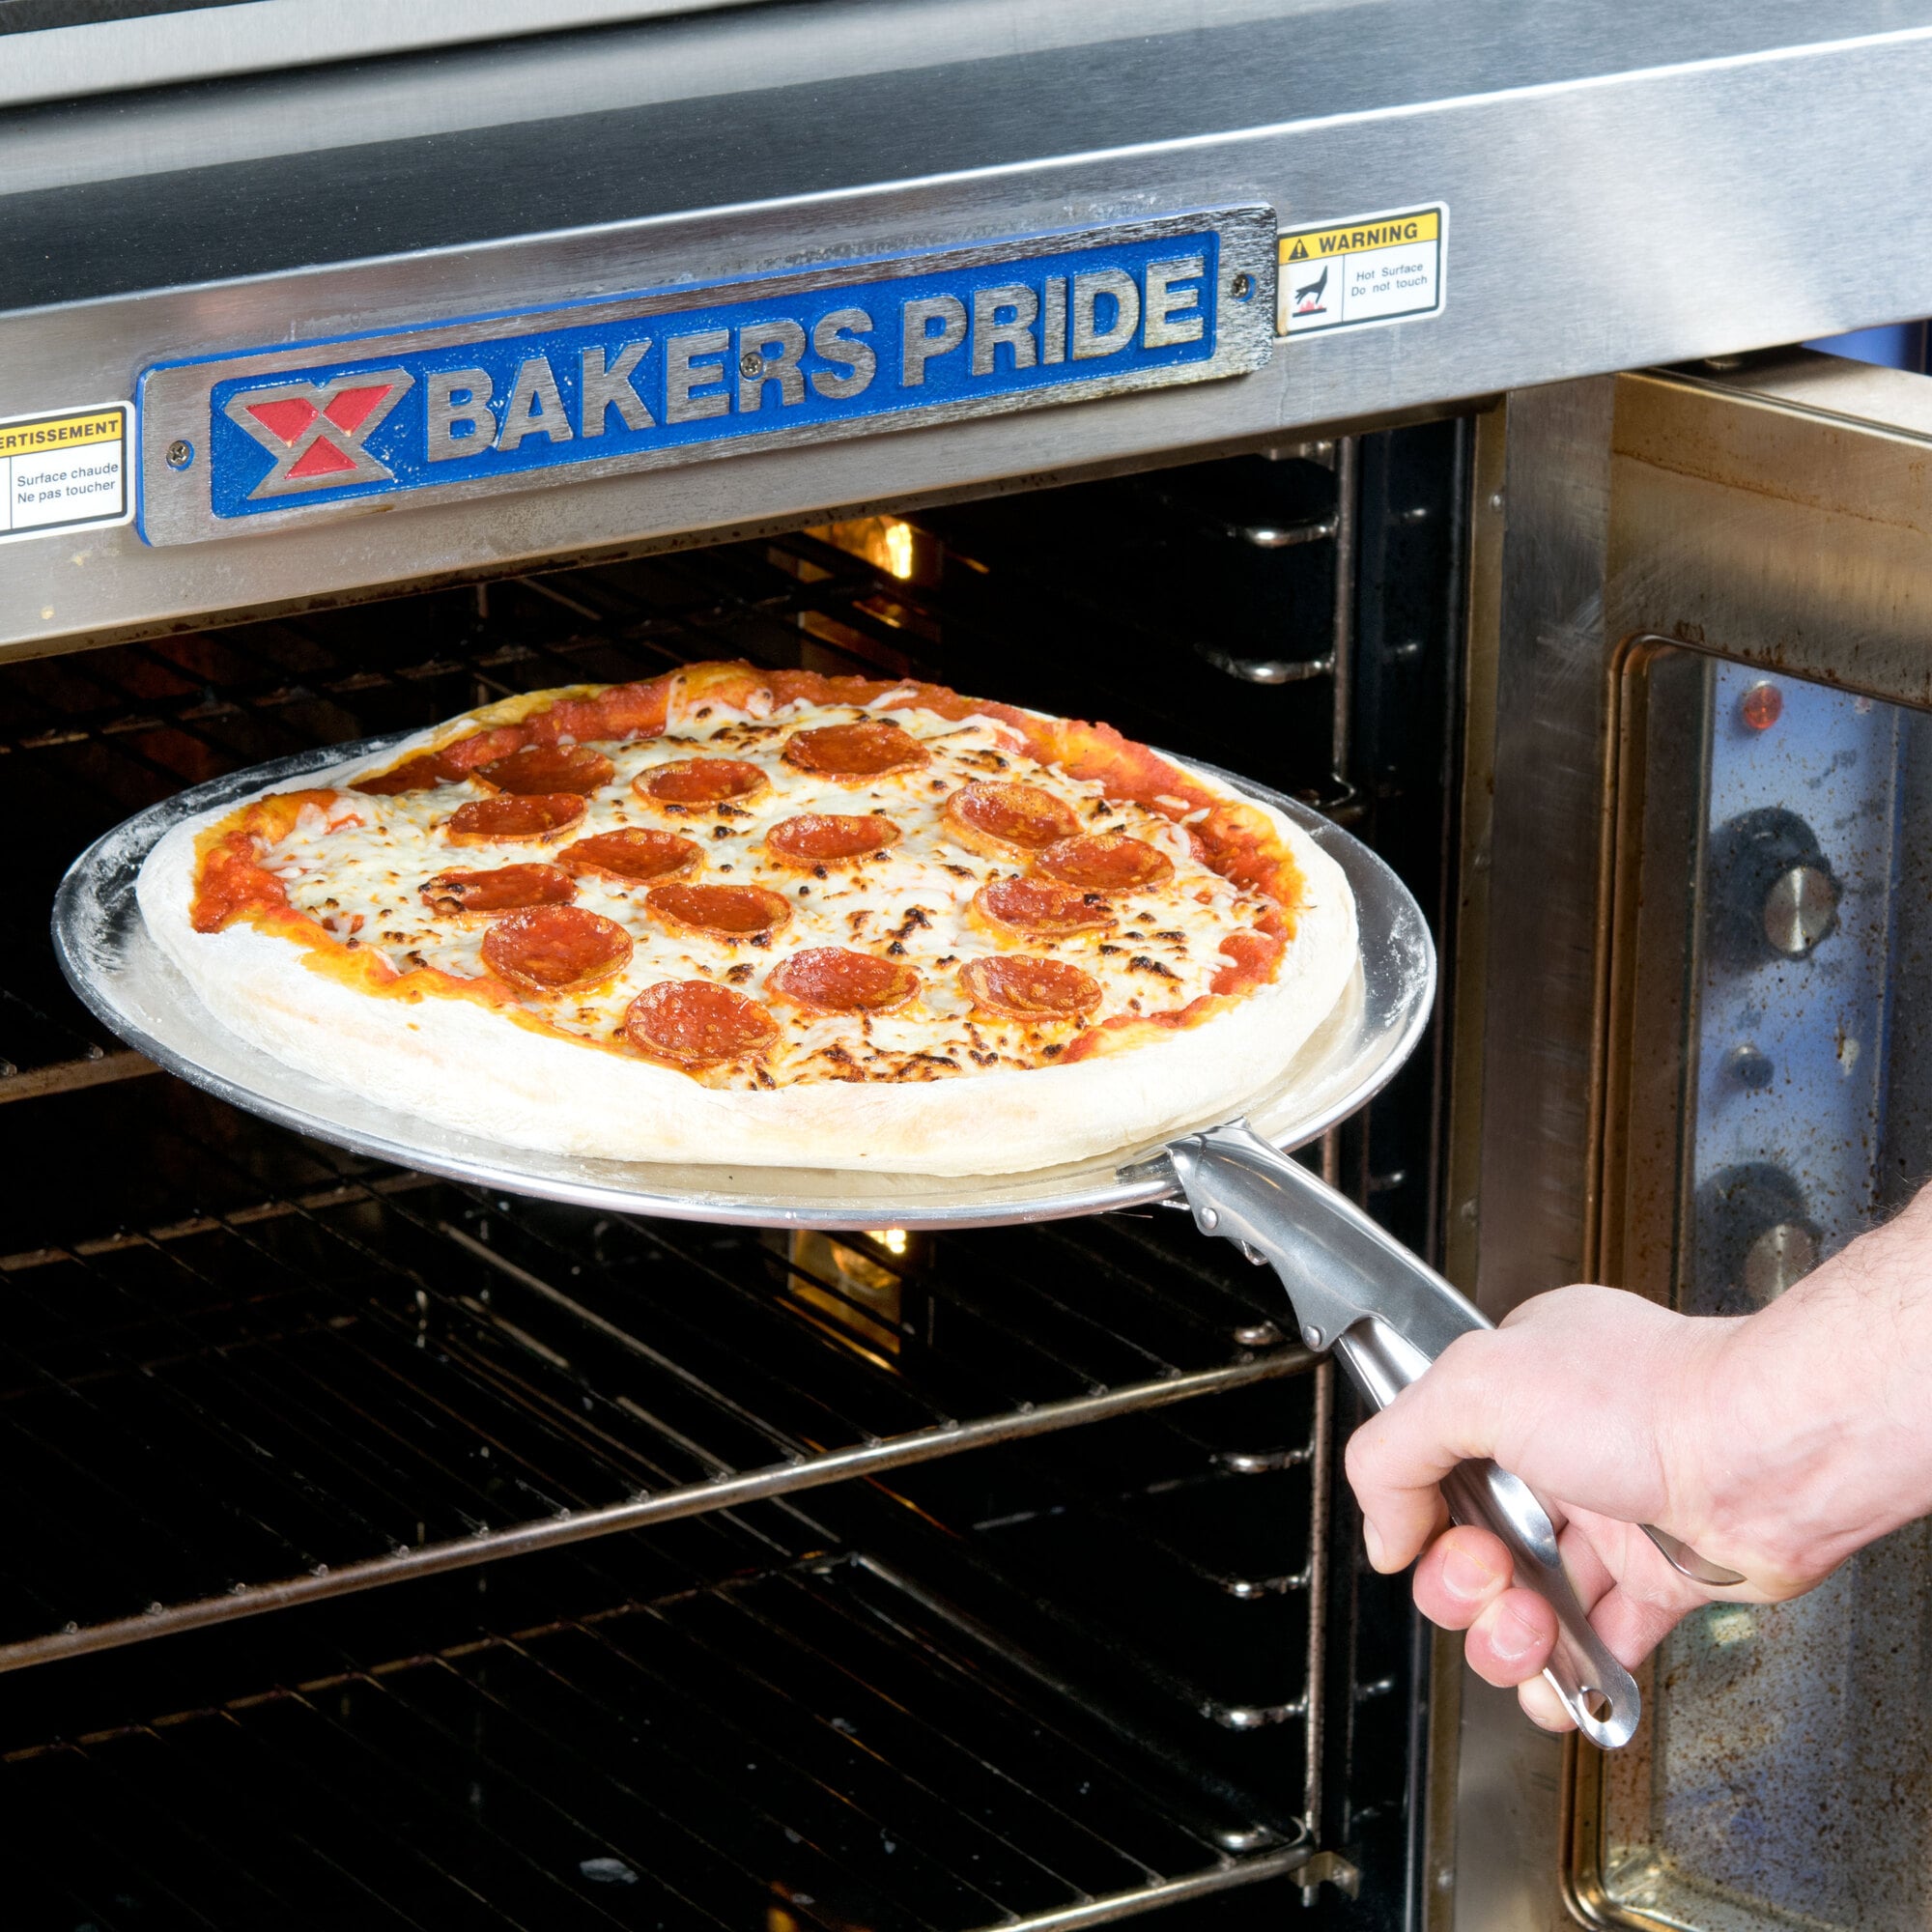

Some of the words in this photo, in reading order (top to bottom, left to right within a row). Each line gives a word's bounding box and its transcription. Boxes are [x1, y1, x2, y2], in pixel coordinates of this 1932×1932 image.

[1319, 222, 1418, 253] WARNING
[1355, 270, 1376, 282] Hot
[1381, 263, 1424, 277] Surface
[1350, 286, 1367, 297] Do
[1373, 281, 1391, 294] not
[1396, 275, 1428, 289] touch
[425, 306, 876, 463] BAKERS
[901, 254, 1206, 387] PRIDE
[16, 471, 68, 487] Surface
[71, 463, 119, 479] chaude
[17, 493, 35, 504] Ne
[39, 489, 62, 503] pas
[66, 480, 116, 497] toucher
